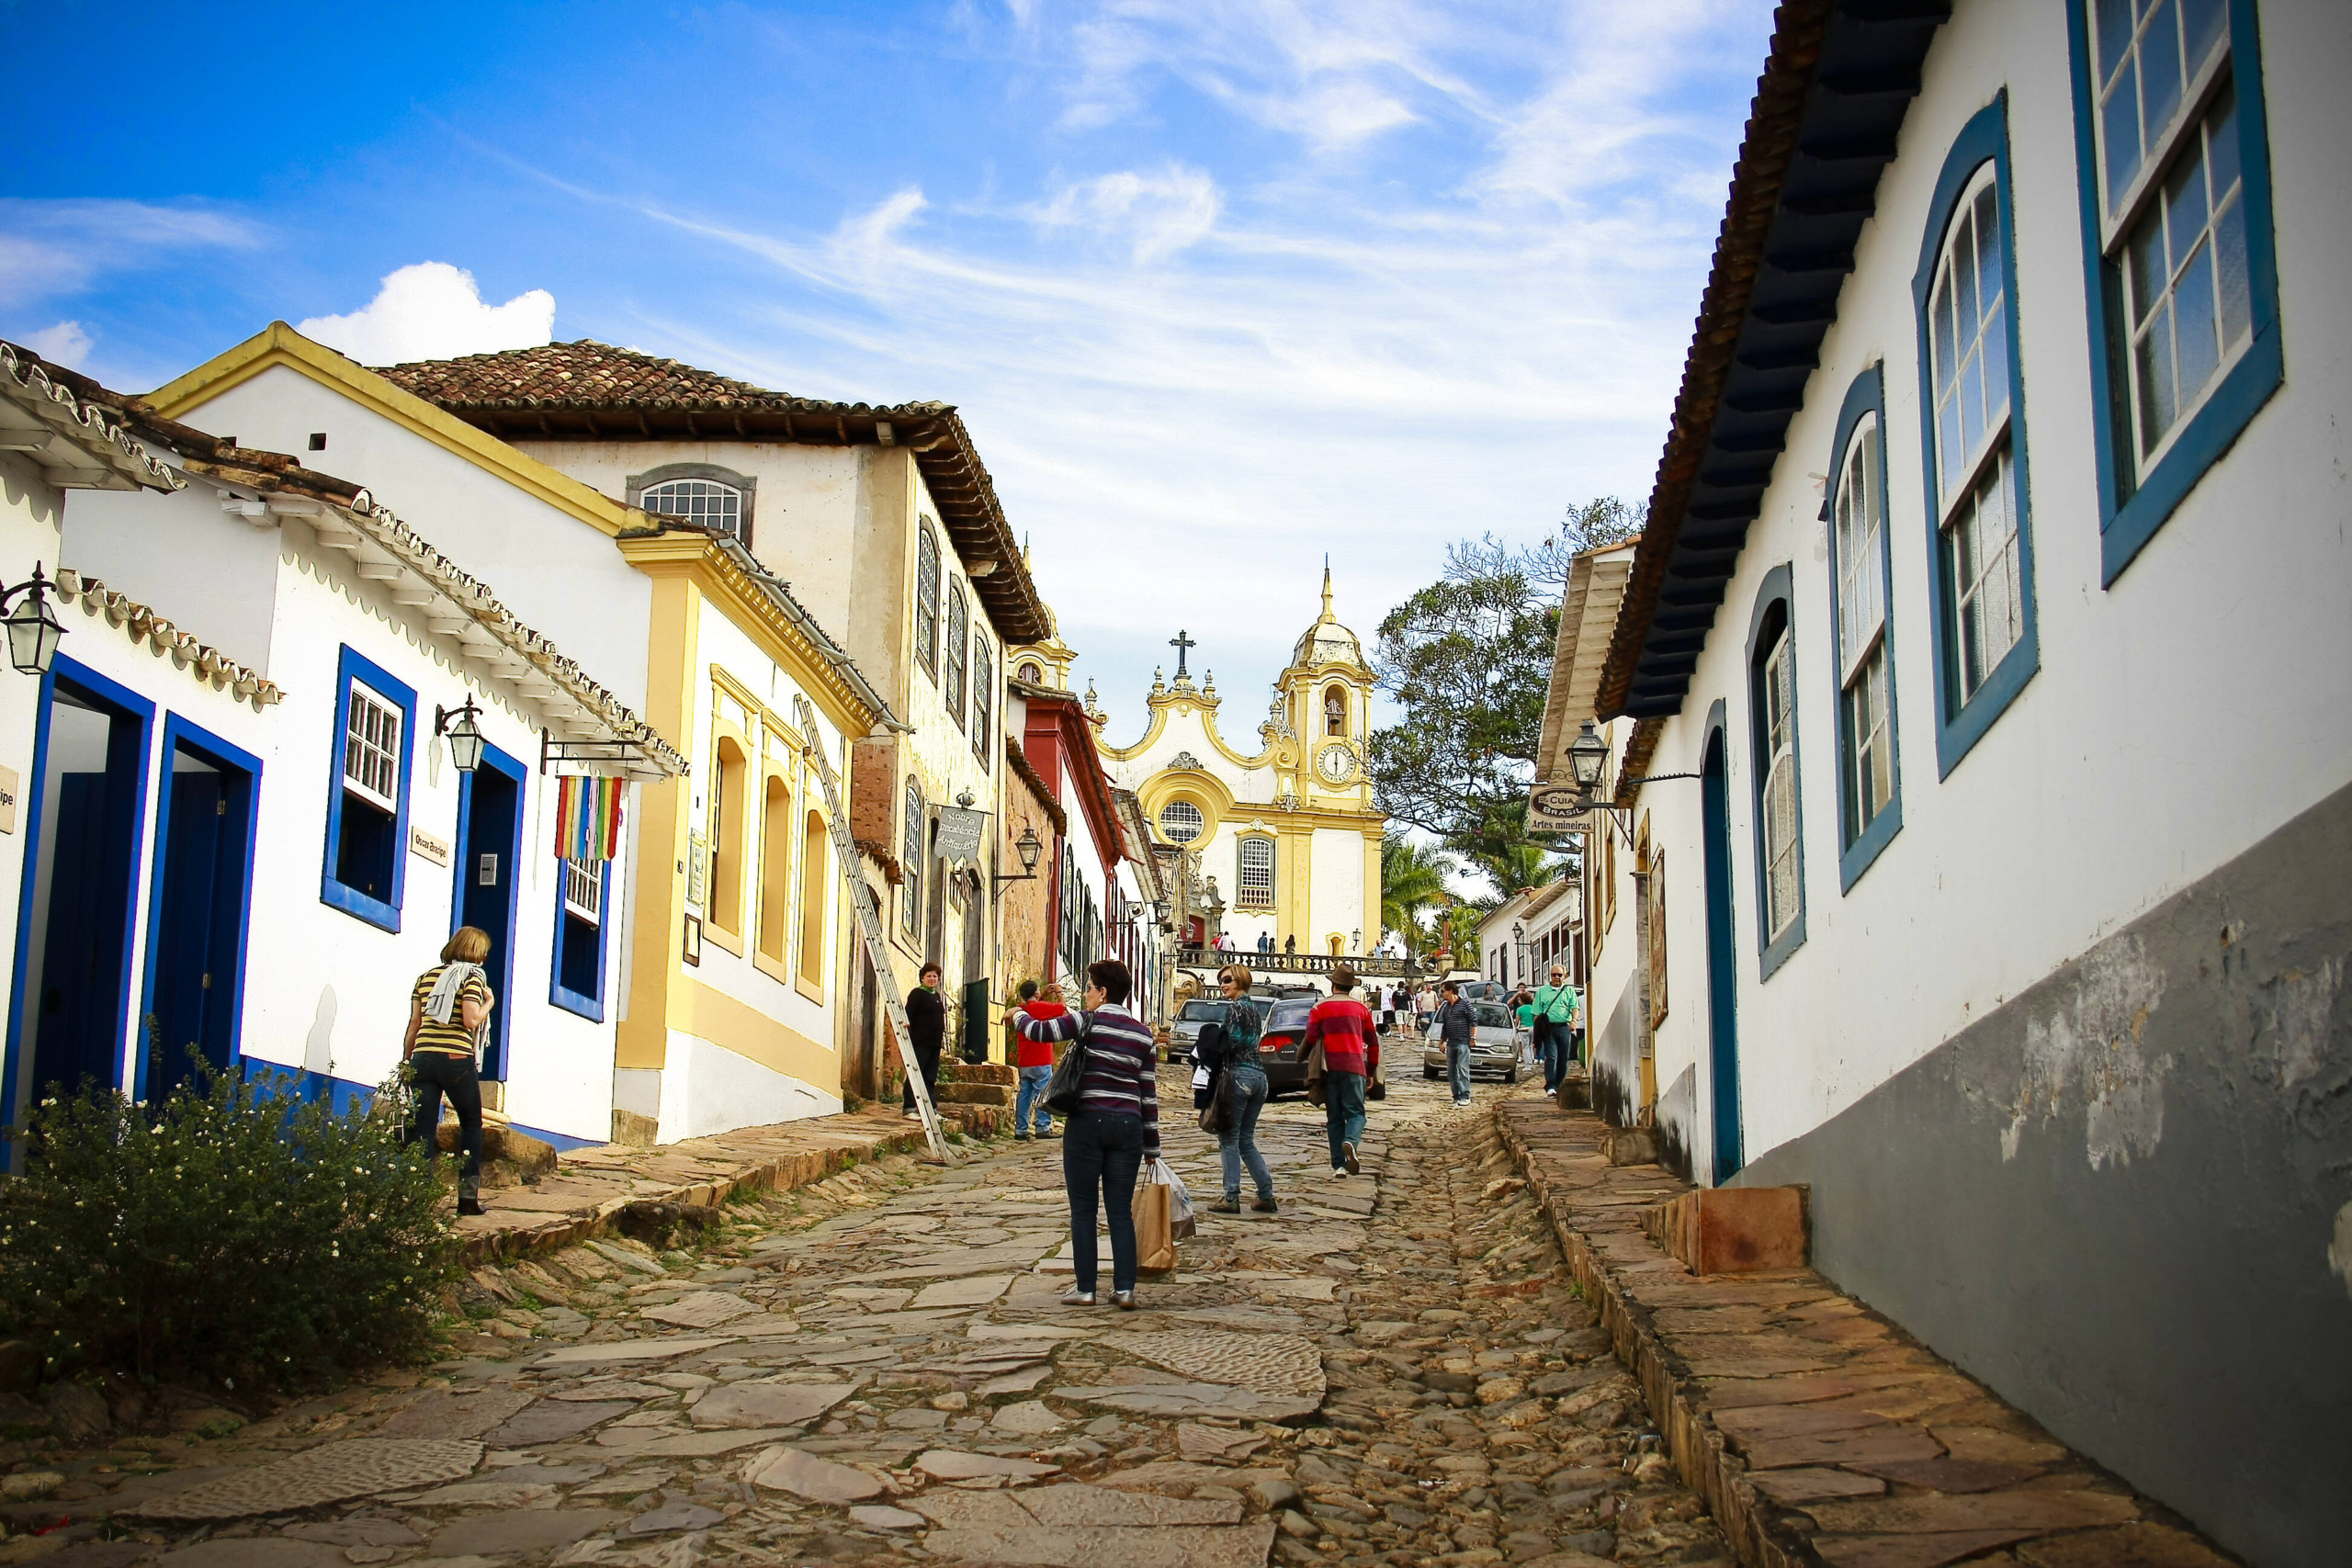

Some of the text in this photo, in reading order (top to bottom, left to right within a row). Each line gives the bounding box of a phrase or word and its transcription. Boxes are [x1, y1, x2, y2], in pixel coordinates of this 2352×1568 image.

[0, 788, 14, 807] ipe
[1543, 806, 1584, 816] BRASIL
[947, 813, 975, 825] Nobre
[1532, 820, 1591, 830] Artes mineiras
[939, 823, 980, 837] Decadência
[415, 834, 429, 850] Oscar
[937, 834, 978, 852] Antiquário
